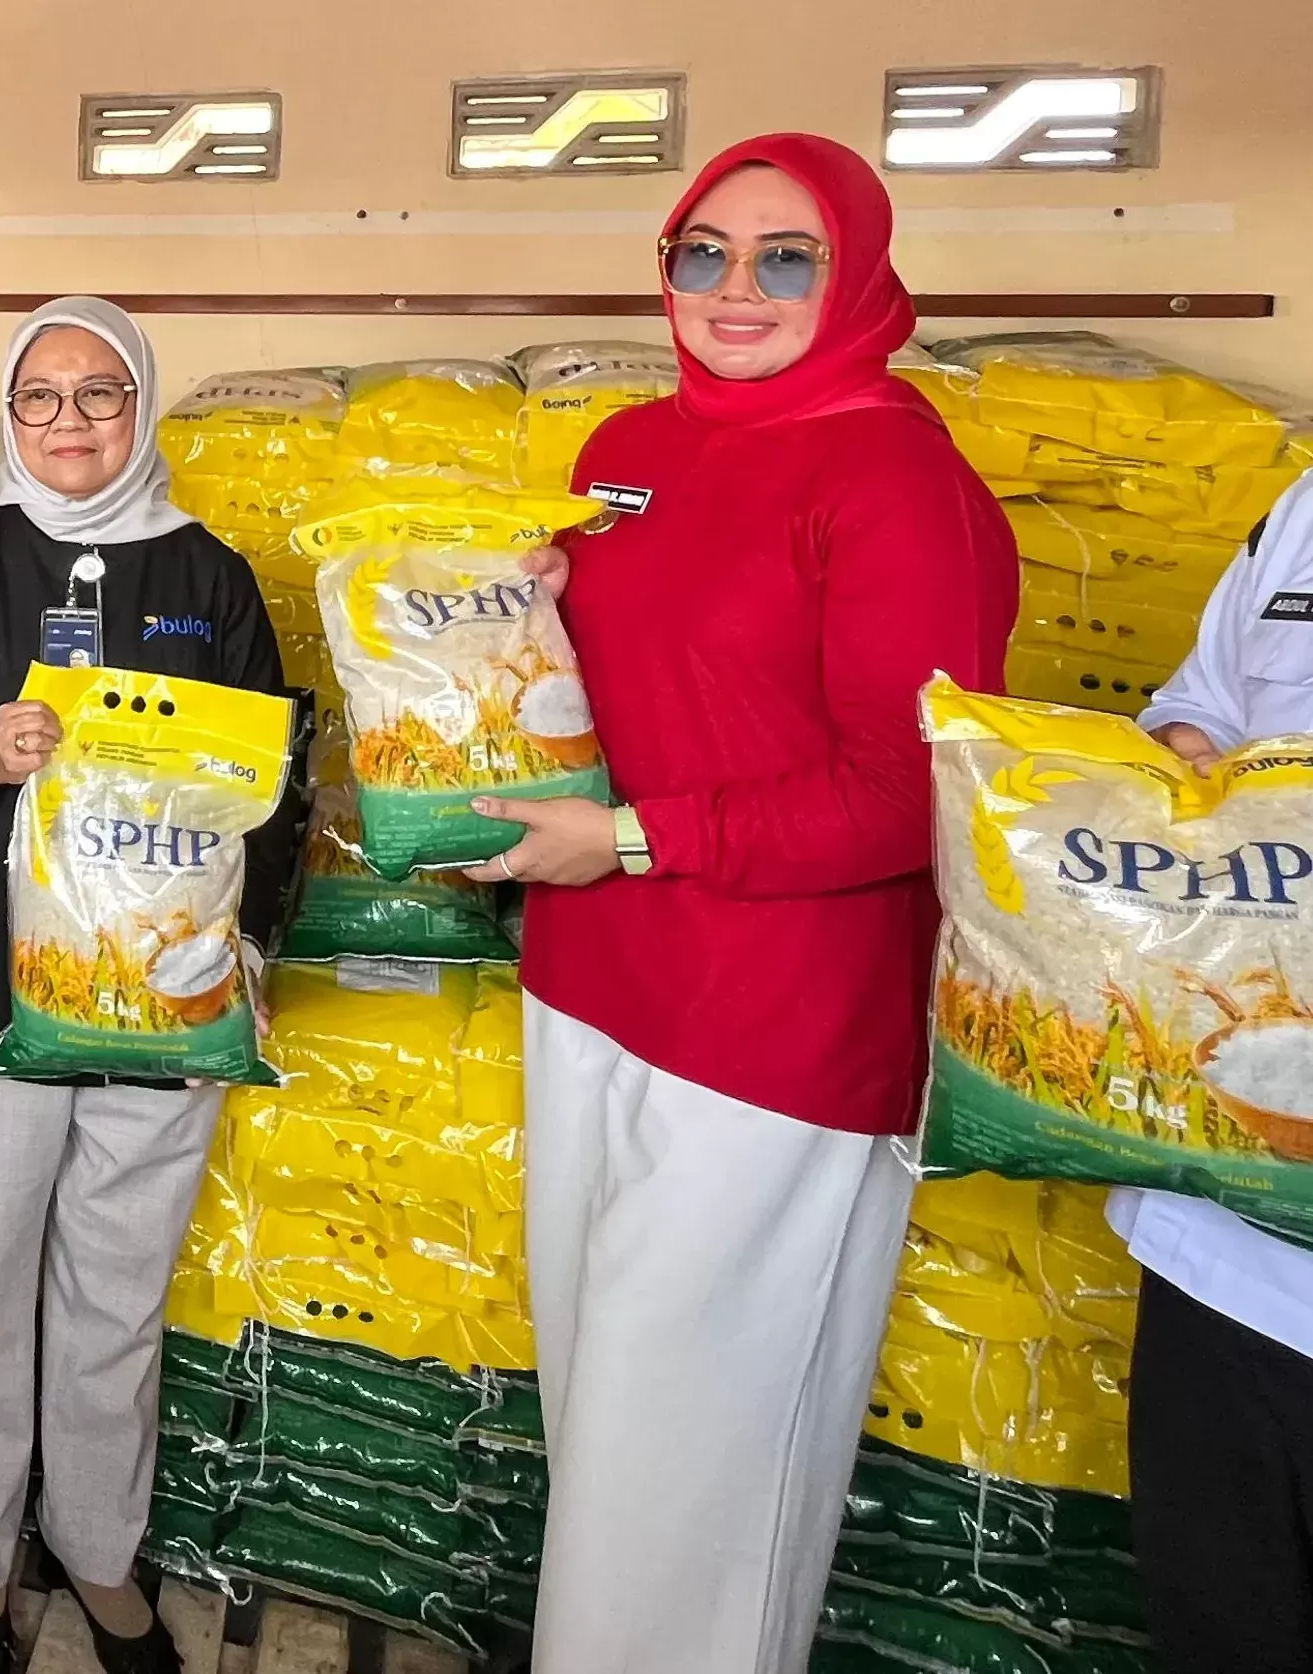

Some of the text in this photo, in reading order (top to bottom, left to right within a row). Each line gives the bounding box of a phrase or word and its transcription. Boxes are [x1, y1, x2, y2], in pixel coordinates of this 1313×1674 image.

[405, 578, 536, 627] SPHP
[159, 614, 212, 643] bulog
[469, 745, 488, 771] 5
[77, 816, 221, 867] SPHP
[1058, 828, 1313, 904] SPHP
[1107, 1076, 1138, 1111] 5
